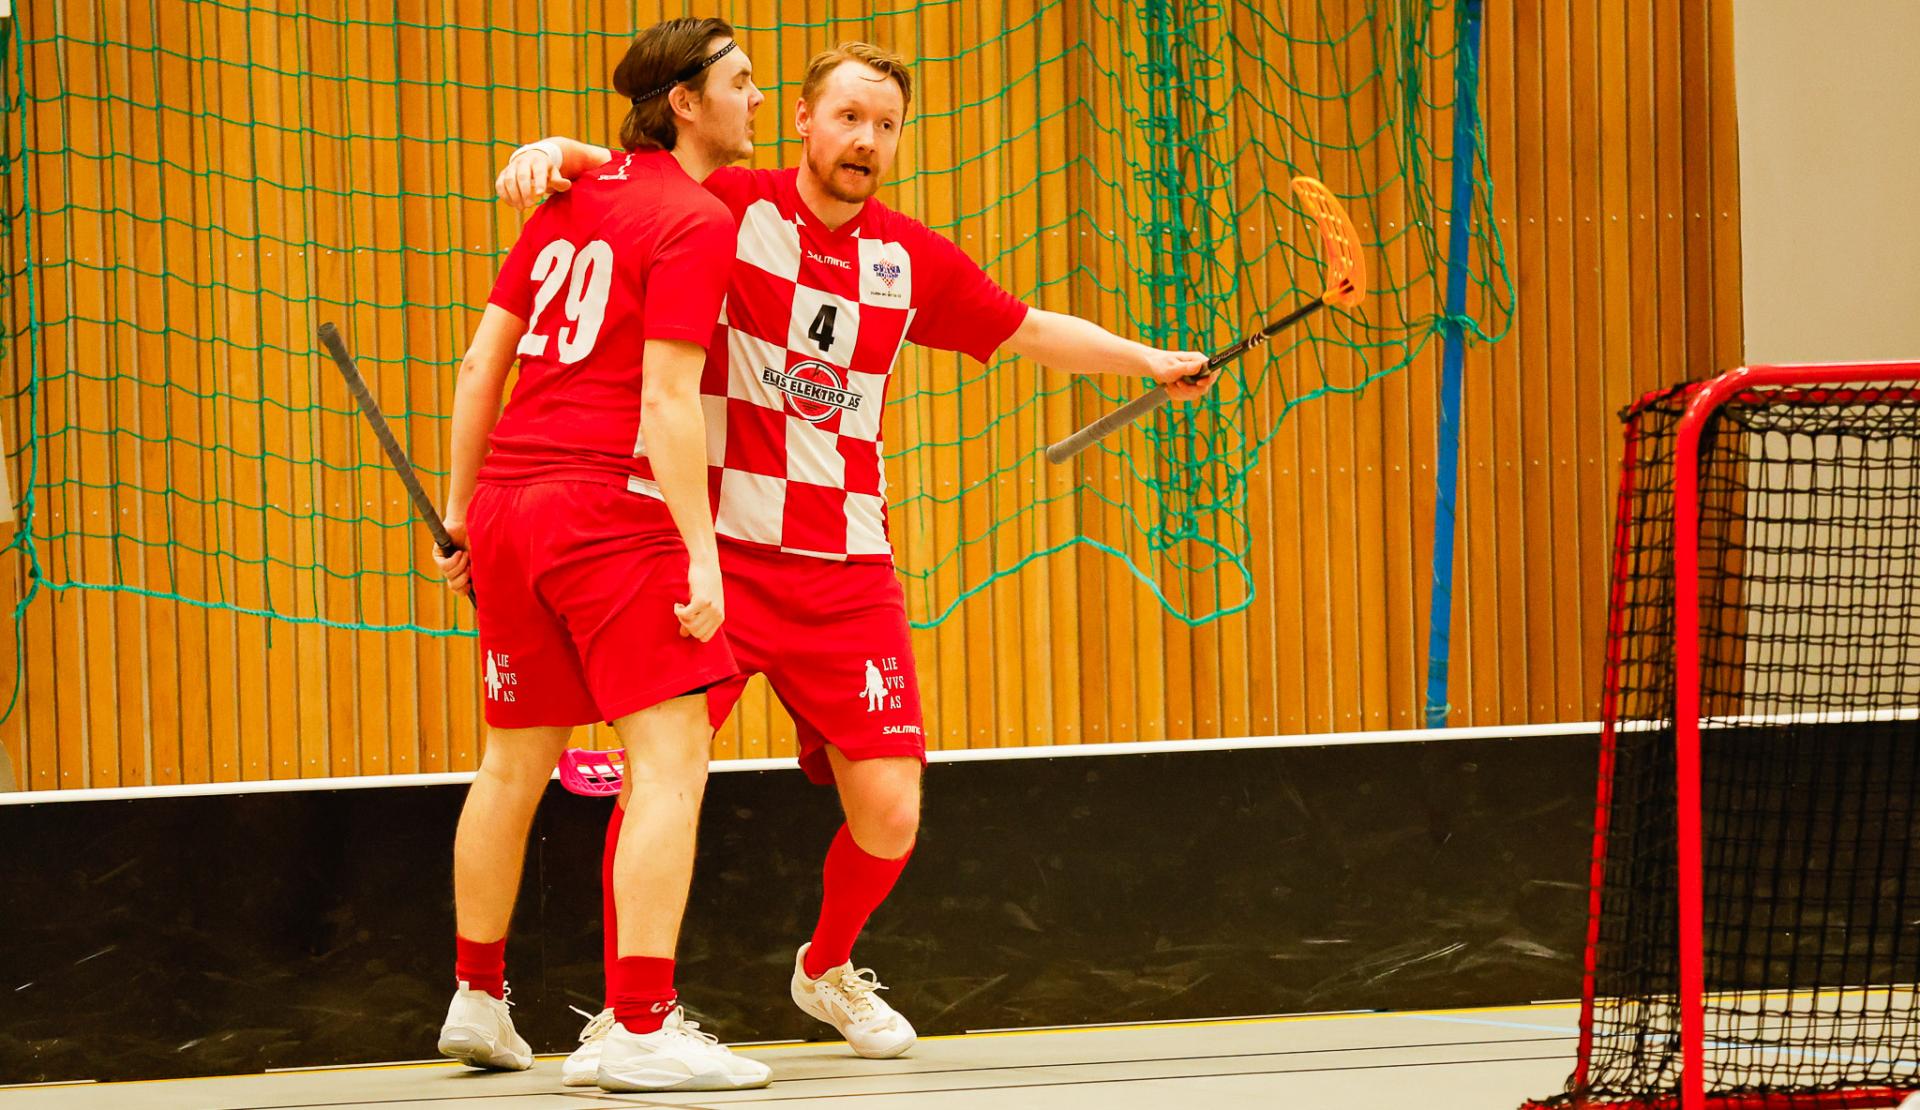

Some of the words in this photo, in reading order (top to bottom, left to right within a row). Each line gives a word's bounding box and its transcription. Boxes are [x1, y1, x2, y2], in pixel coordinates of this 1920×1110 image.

[806, 249, 853, 270] SALMING
[516, 238, 614, 365] 29
[808, 304, 838, 353] 4
[762, 369, 787, 388] ELIS
[790, 381, 845, 404] ELEKTRO
[848, 396, 861, 409] AS
[496, 653, 510, 668] LIE
[882, 657, 898, 671] LIE
[499, 672, 518, 685] VVS
[885, 675, 905, 690] VVS
[503, 690, 516, 703] AS
[890, 695, 902, 709] AS
